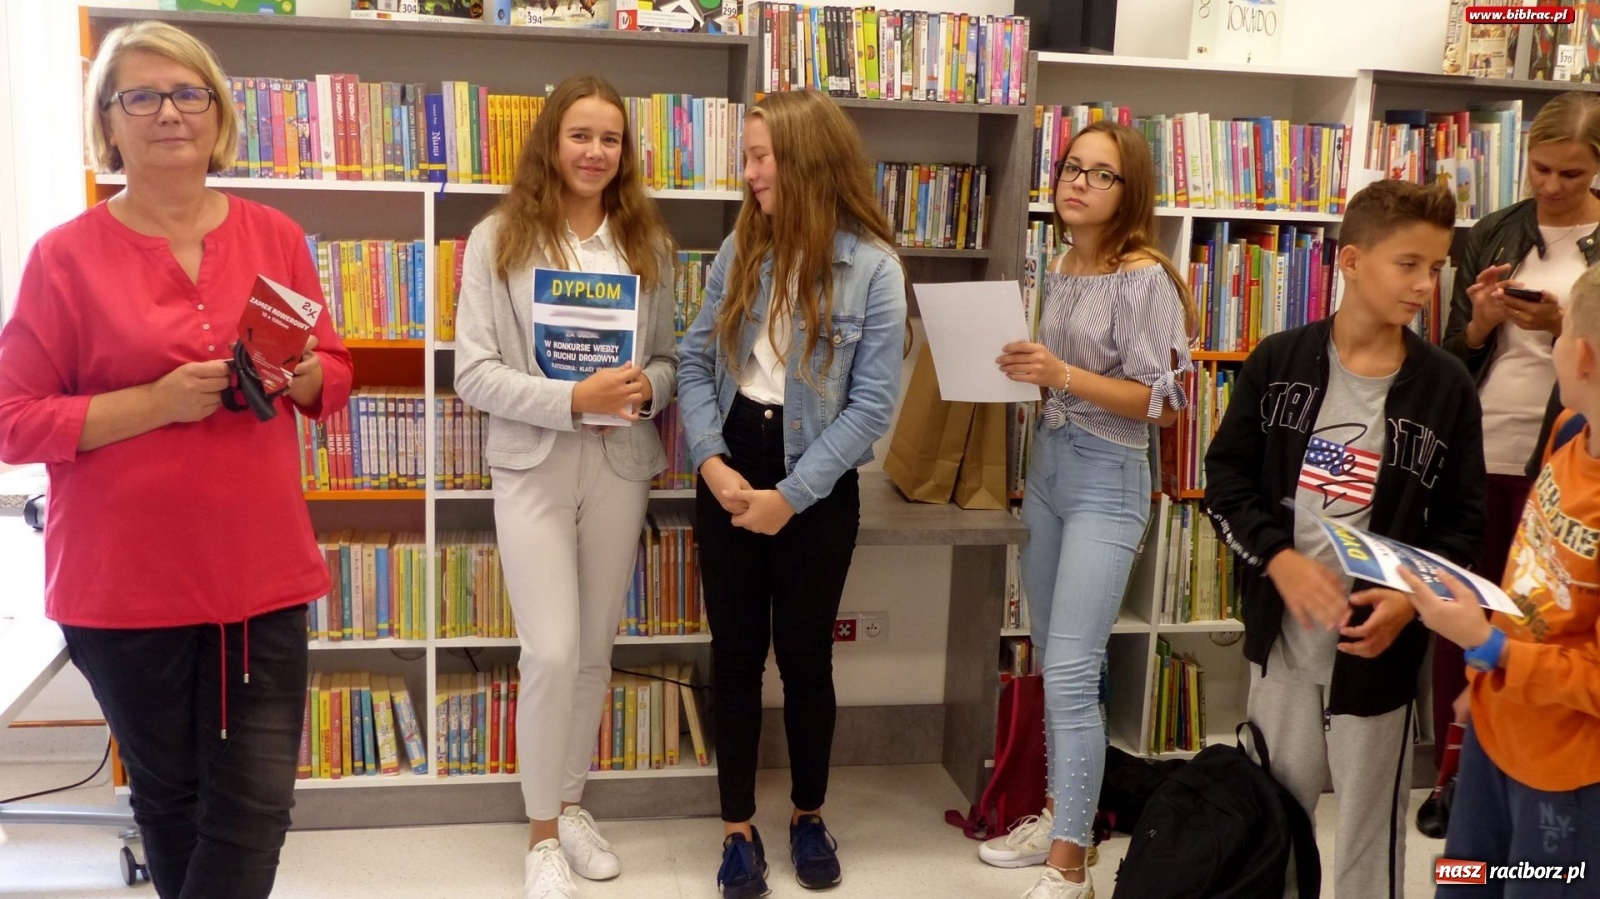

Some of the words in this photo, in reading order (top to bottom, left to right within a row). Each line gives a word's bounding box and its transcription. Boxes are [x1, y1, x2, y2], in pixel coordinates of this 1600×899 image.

[402, 4, 417, 13] 304
[723, 6, 736, 16] 299
[527, 15, 542, 24] 394
[1560, 55, 1572, 64] 370
[551, 280, 621, 300] DYPLOM
[250, 297, 273, 312] ZAMEK
[272, 309, 310, 331] ROWEROWY
[544, 340, 552, 348] W
[553, 341, 591, 352] KONKURSIE
[593, 344, 619, 353] WIEDZY
[553, 352, 576, 361] RUCHU
[579, 354, 618, 363] DROGOWYM
